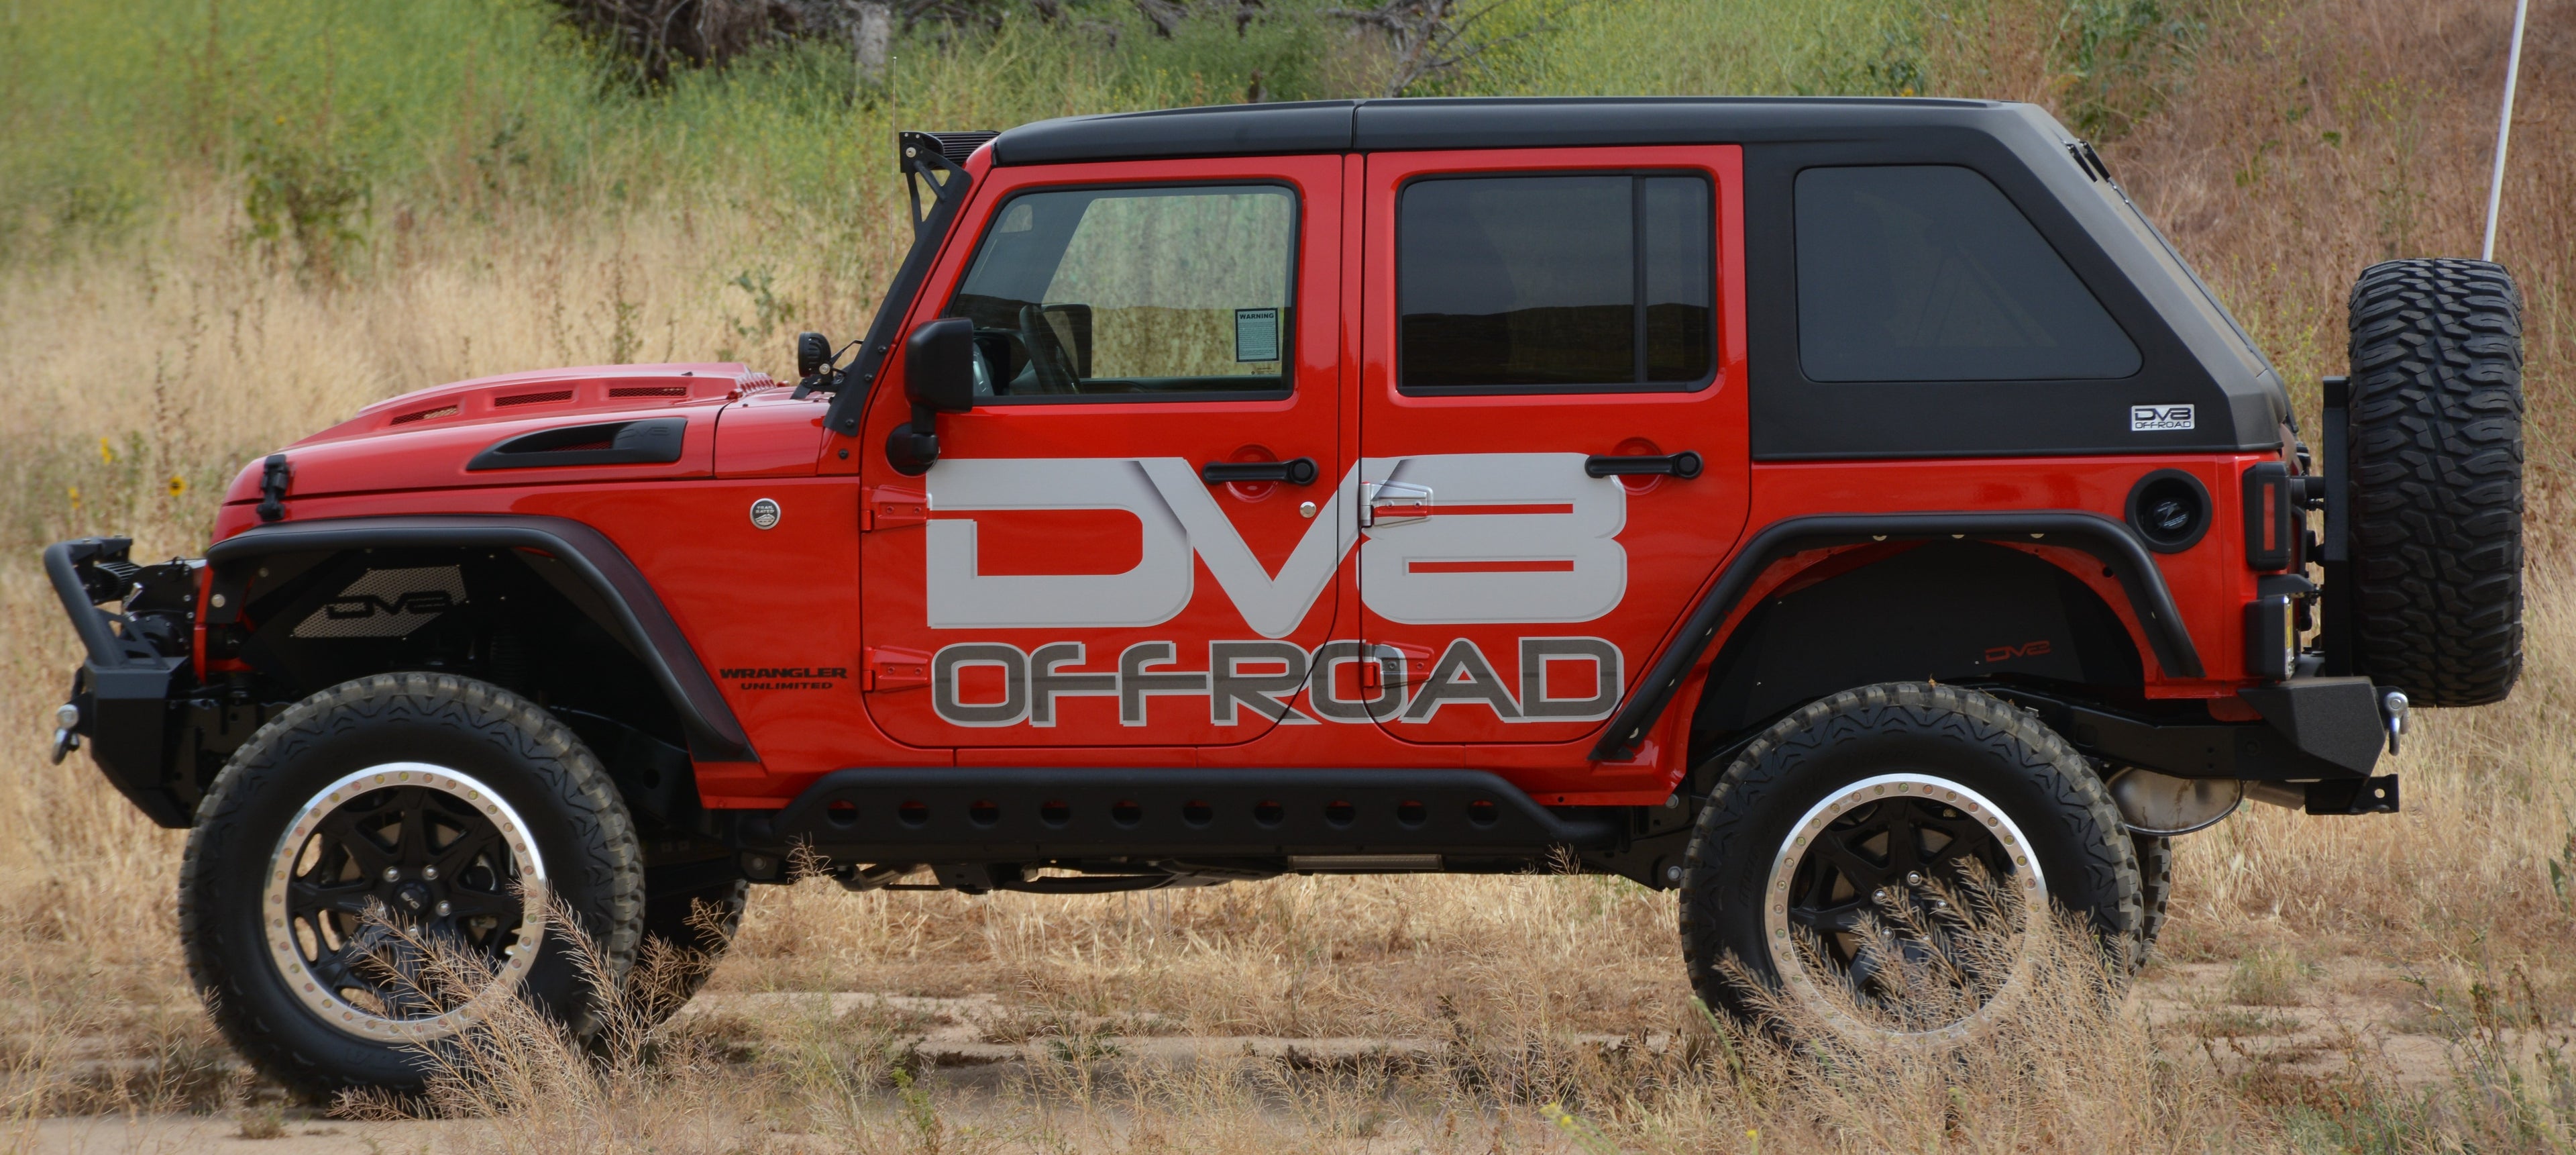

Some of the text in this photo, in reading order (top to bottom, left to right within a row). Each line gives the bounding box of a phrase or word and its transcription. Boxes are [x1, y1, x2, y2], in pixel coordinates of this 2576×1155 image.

[2135, 407, 2192, 421] DV8
[926, 452, 1628, 638] DV8
[326, 590, 453, 620] DV8
[1985, 640, 2051, 662] DV8
[720, 668, 848, 679] WRANGLER
[741, 682, 833, 690] UNLIMITED
